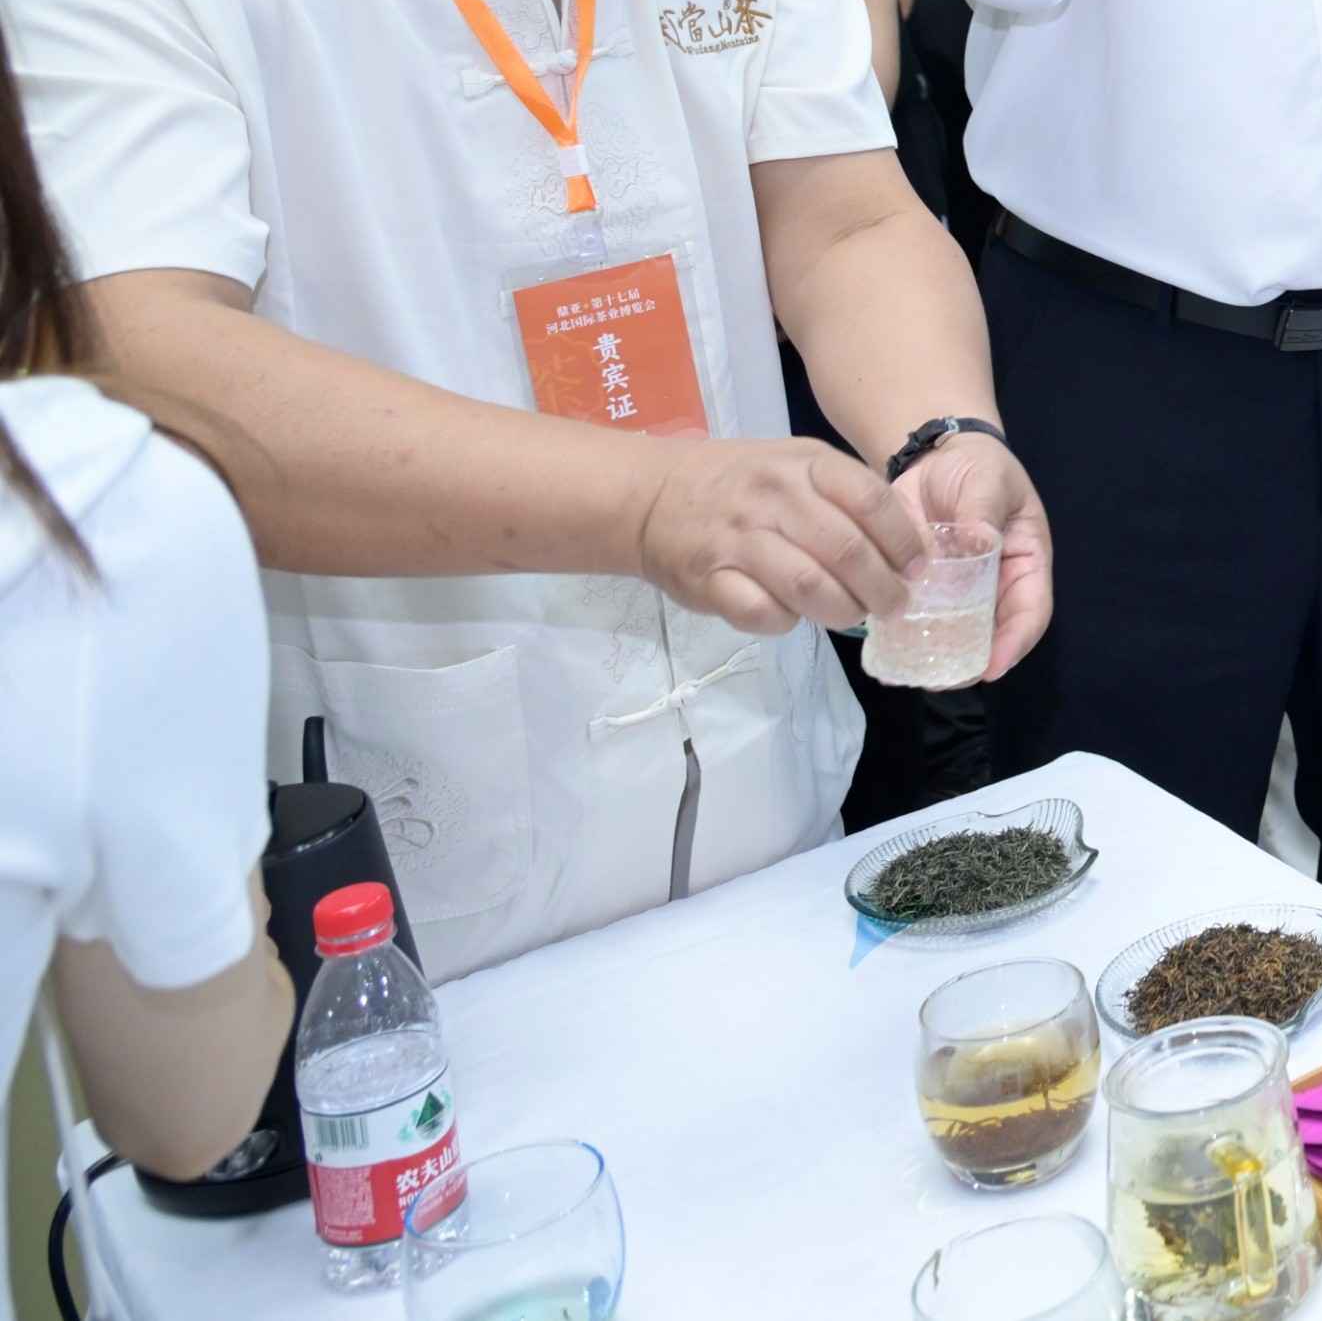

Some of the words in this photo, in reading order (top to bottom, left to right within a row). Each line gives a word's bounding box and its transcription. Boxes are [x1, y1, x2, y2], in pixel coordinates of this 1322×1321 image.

[545, 299, 657, 336] 河北国际茶业博览会
[592, 332, 639, 422] 贵宾证
